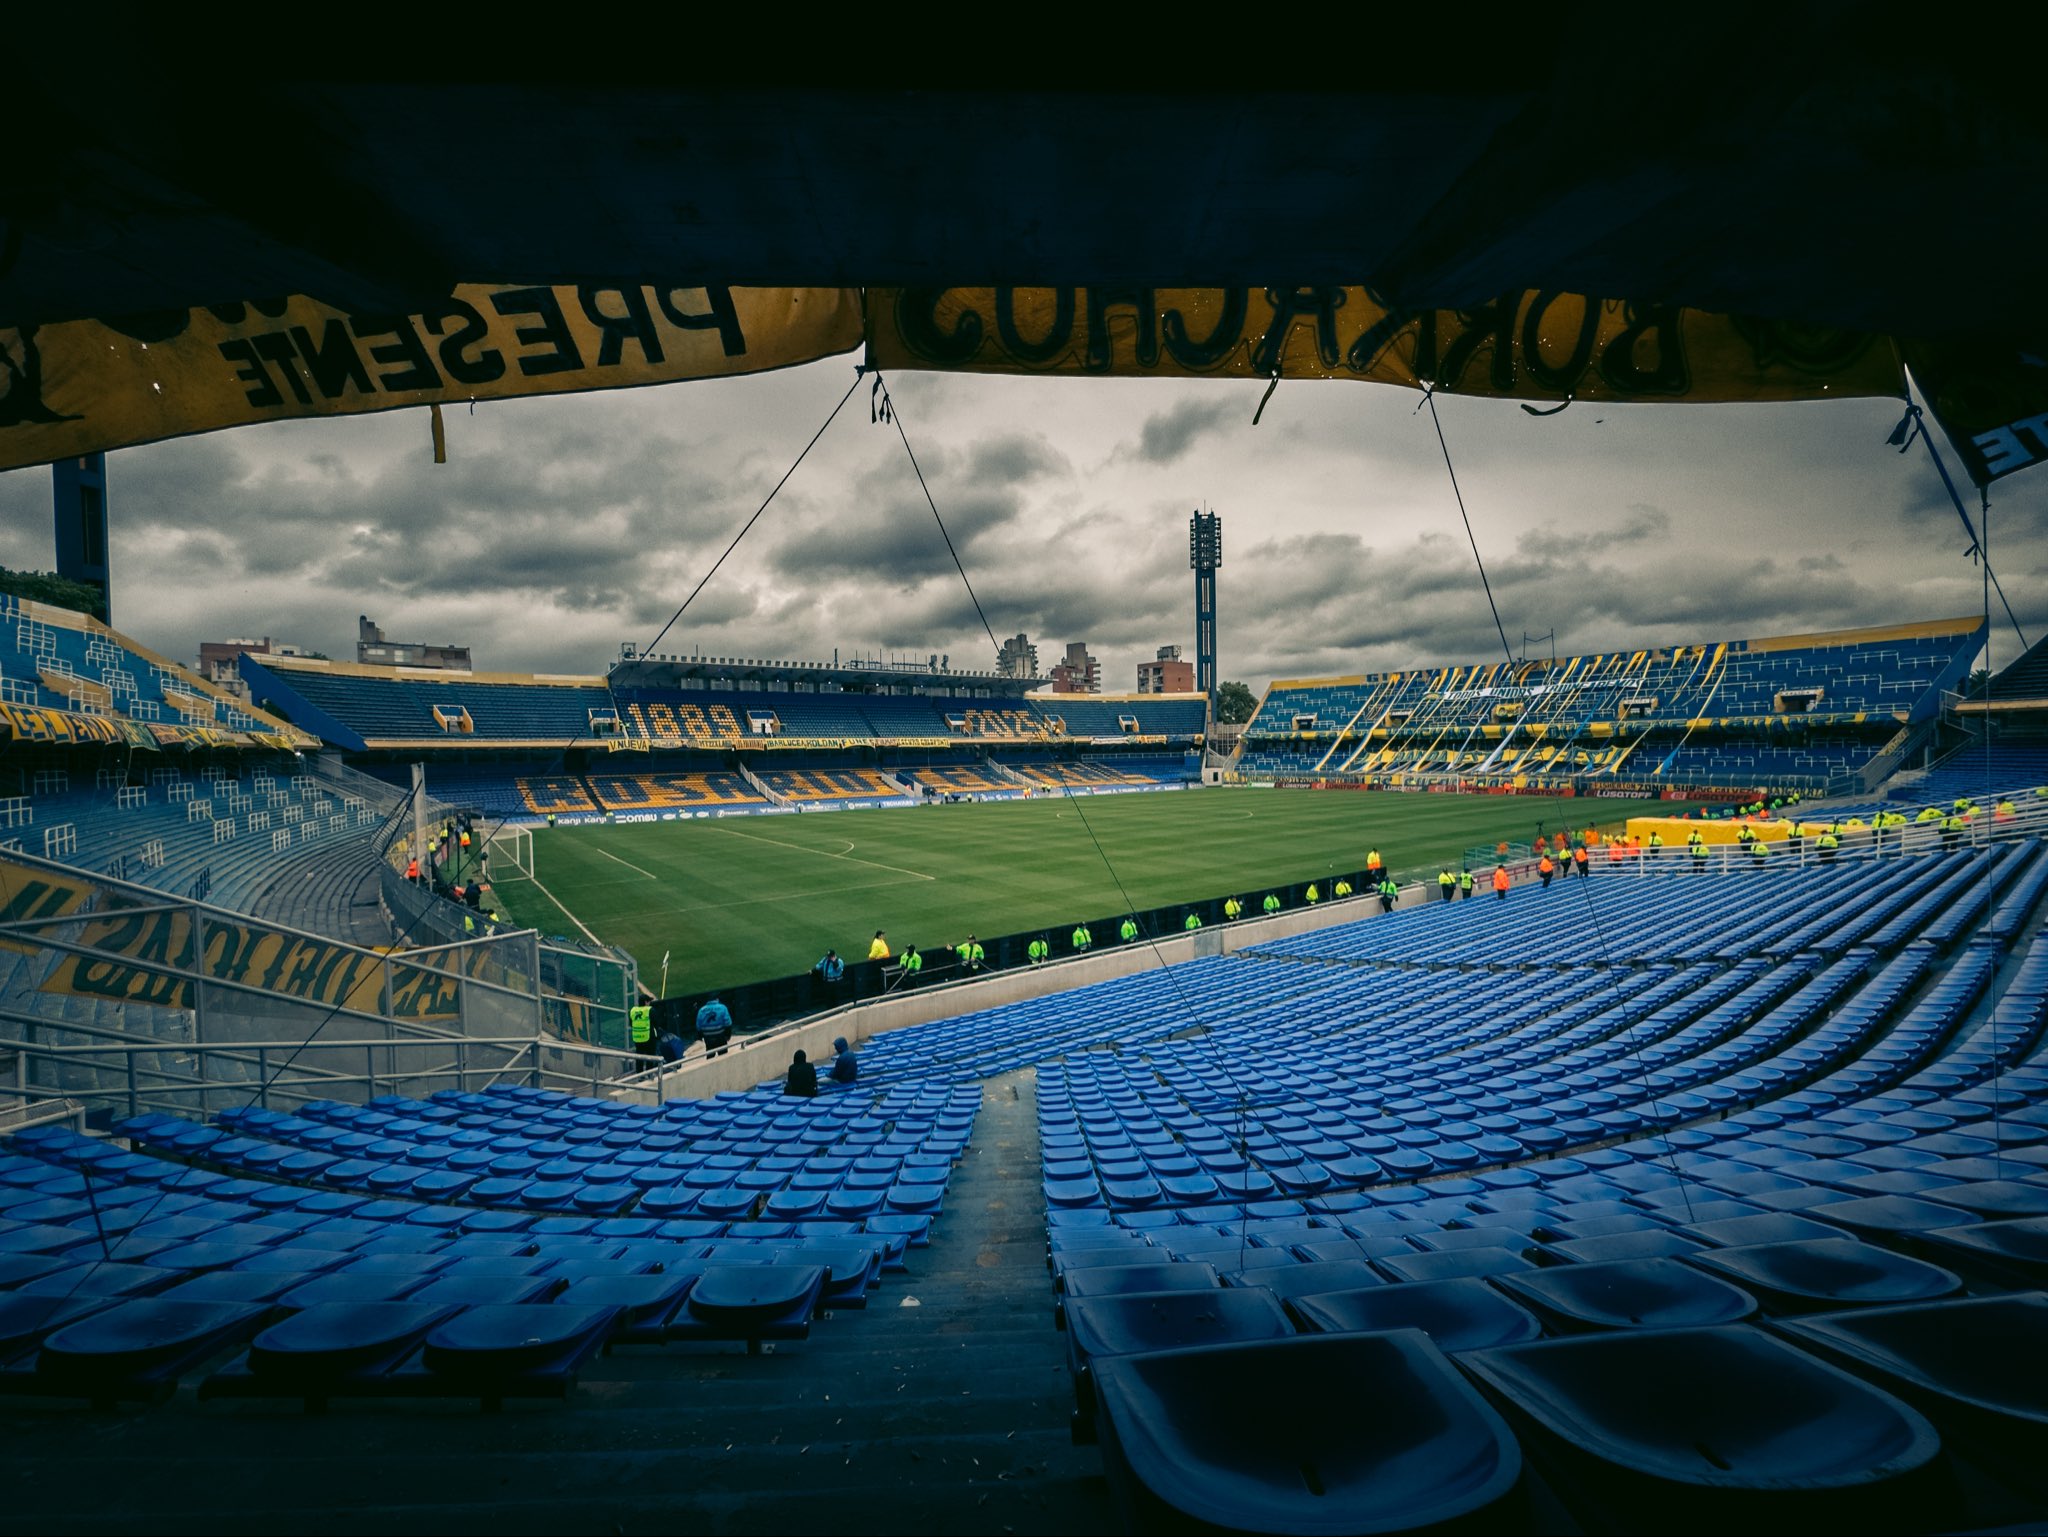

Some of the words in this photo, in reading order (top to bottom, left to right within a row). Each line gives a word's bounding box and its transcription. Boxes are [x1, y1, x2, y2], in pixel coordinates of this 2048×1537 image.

[1448, 690, 1481, 700] TODOS
[1490, 687, 1534, 697] UNIDOS
[628, 703, 742, 738] 1889
[1637, 783, 1666, 791] ZONA
